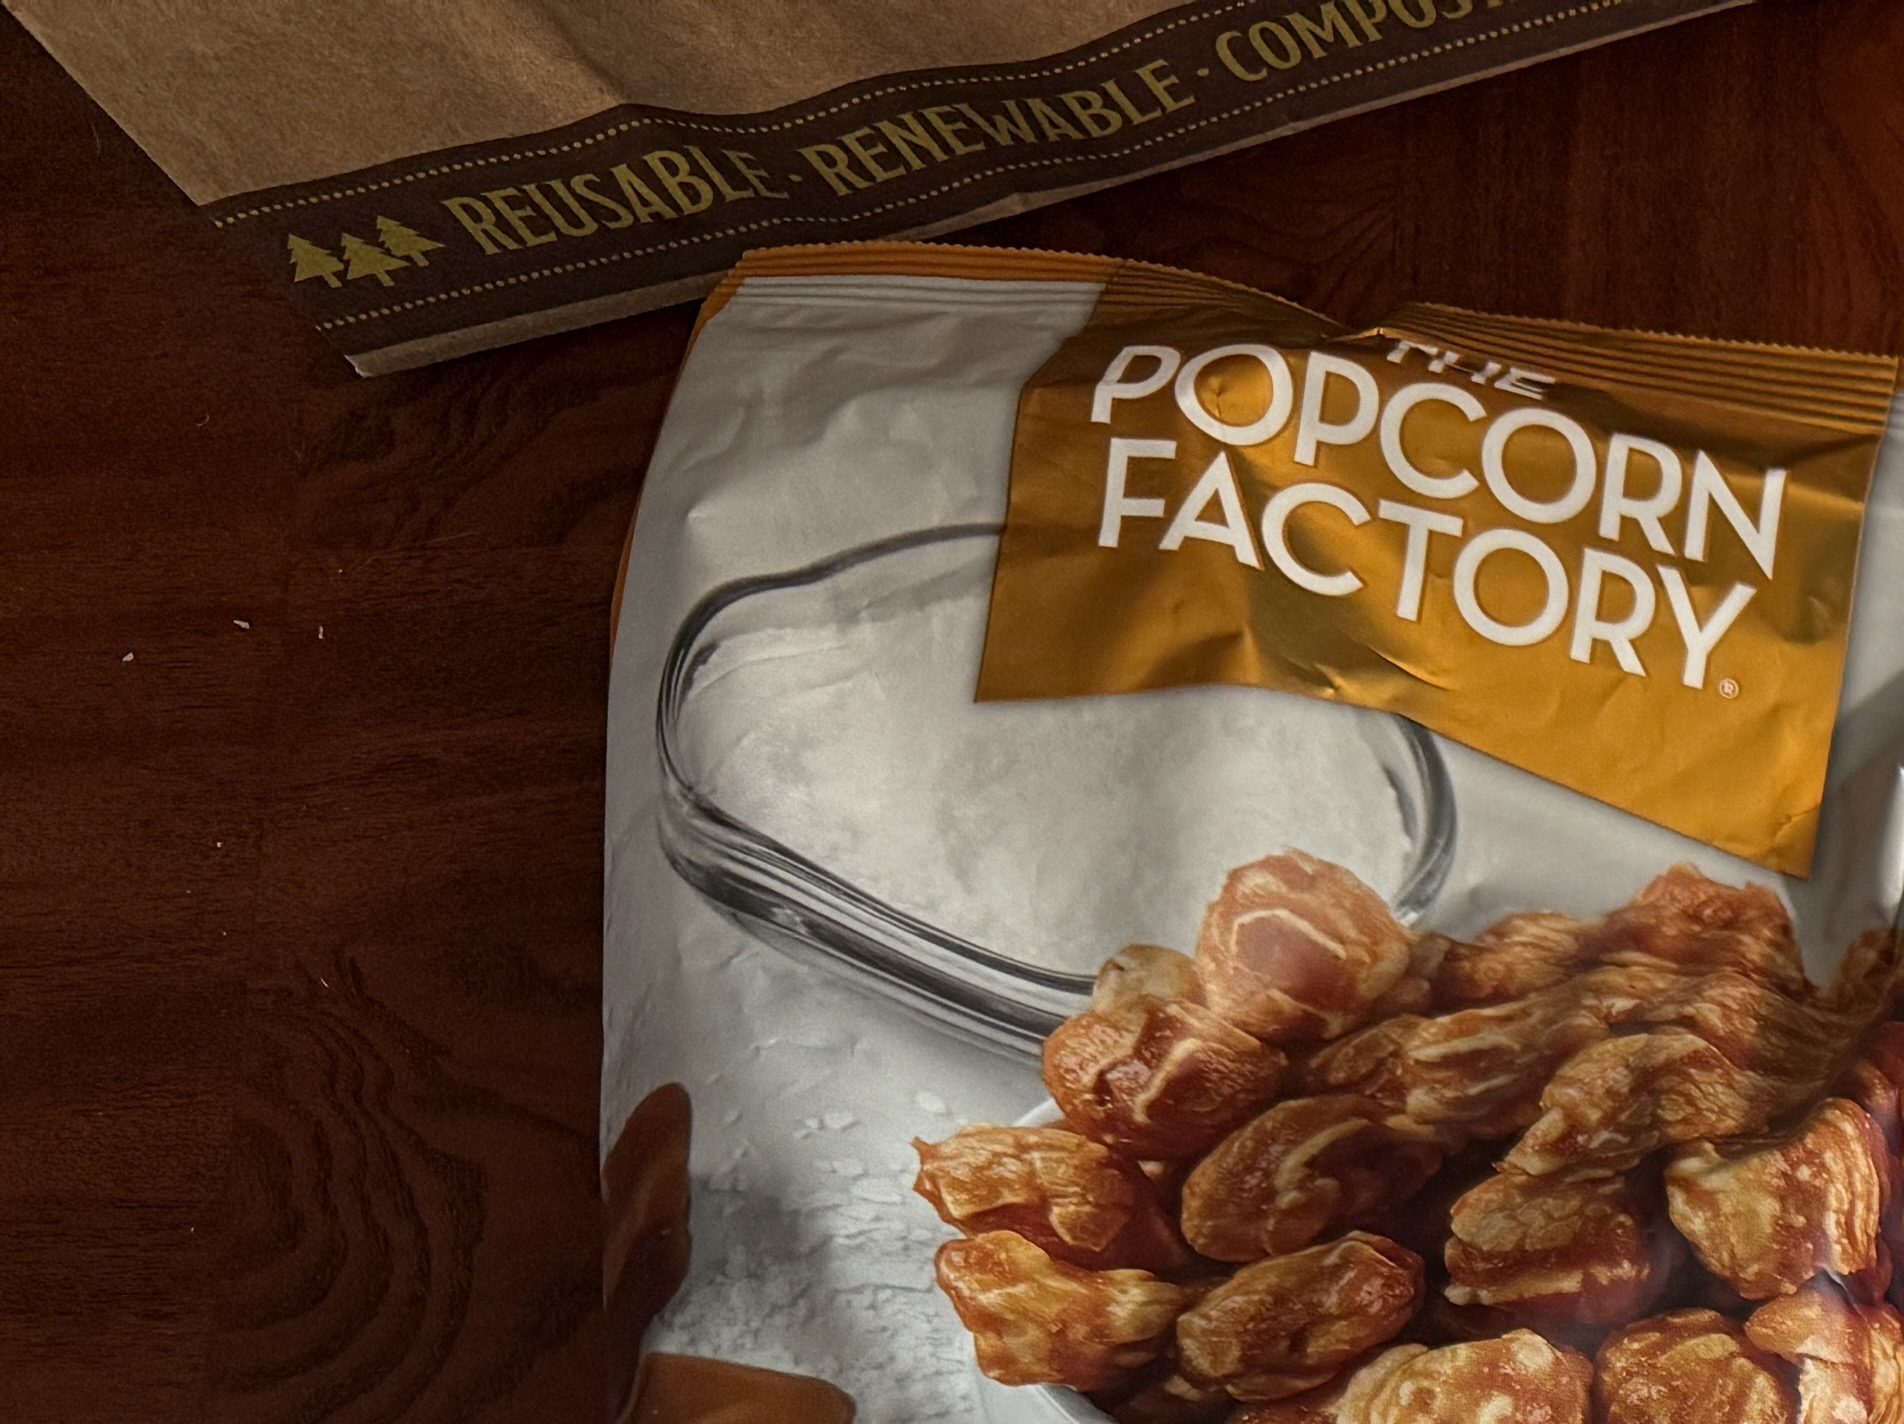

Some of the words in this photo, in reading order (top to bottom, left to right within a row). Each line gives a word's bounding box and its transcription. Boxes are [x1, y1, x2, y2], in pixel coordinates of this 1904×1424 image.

[443, 145, 788, 255] REUSABLE
[803, 59, 1195, 197] RENEWABLE
[1090, 343, 1787, 579] POPCORN
